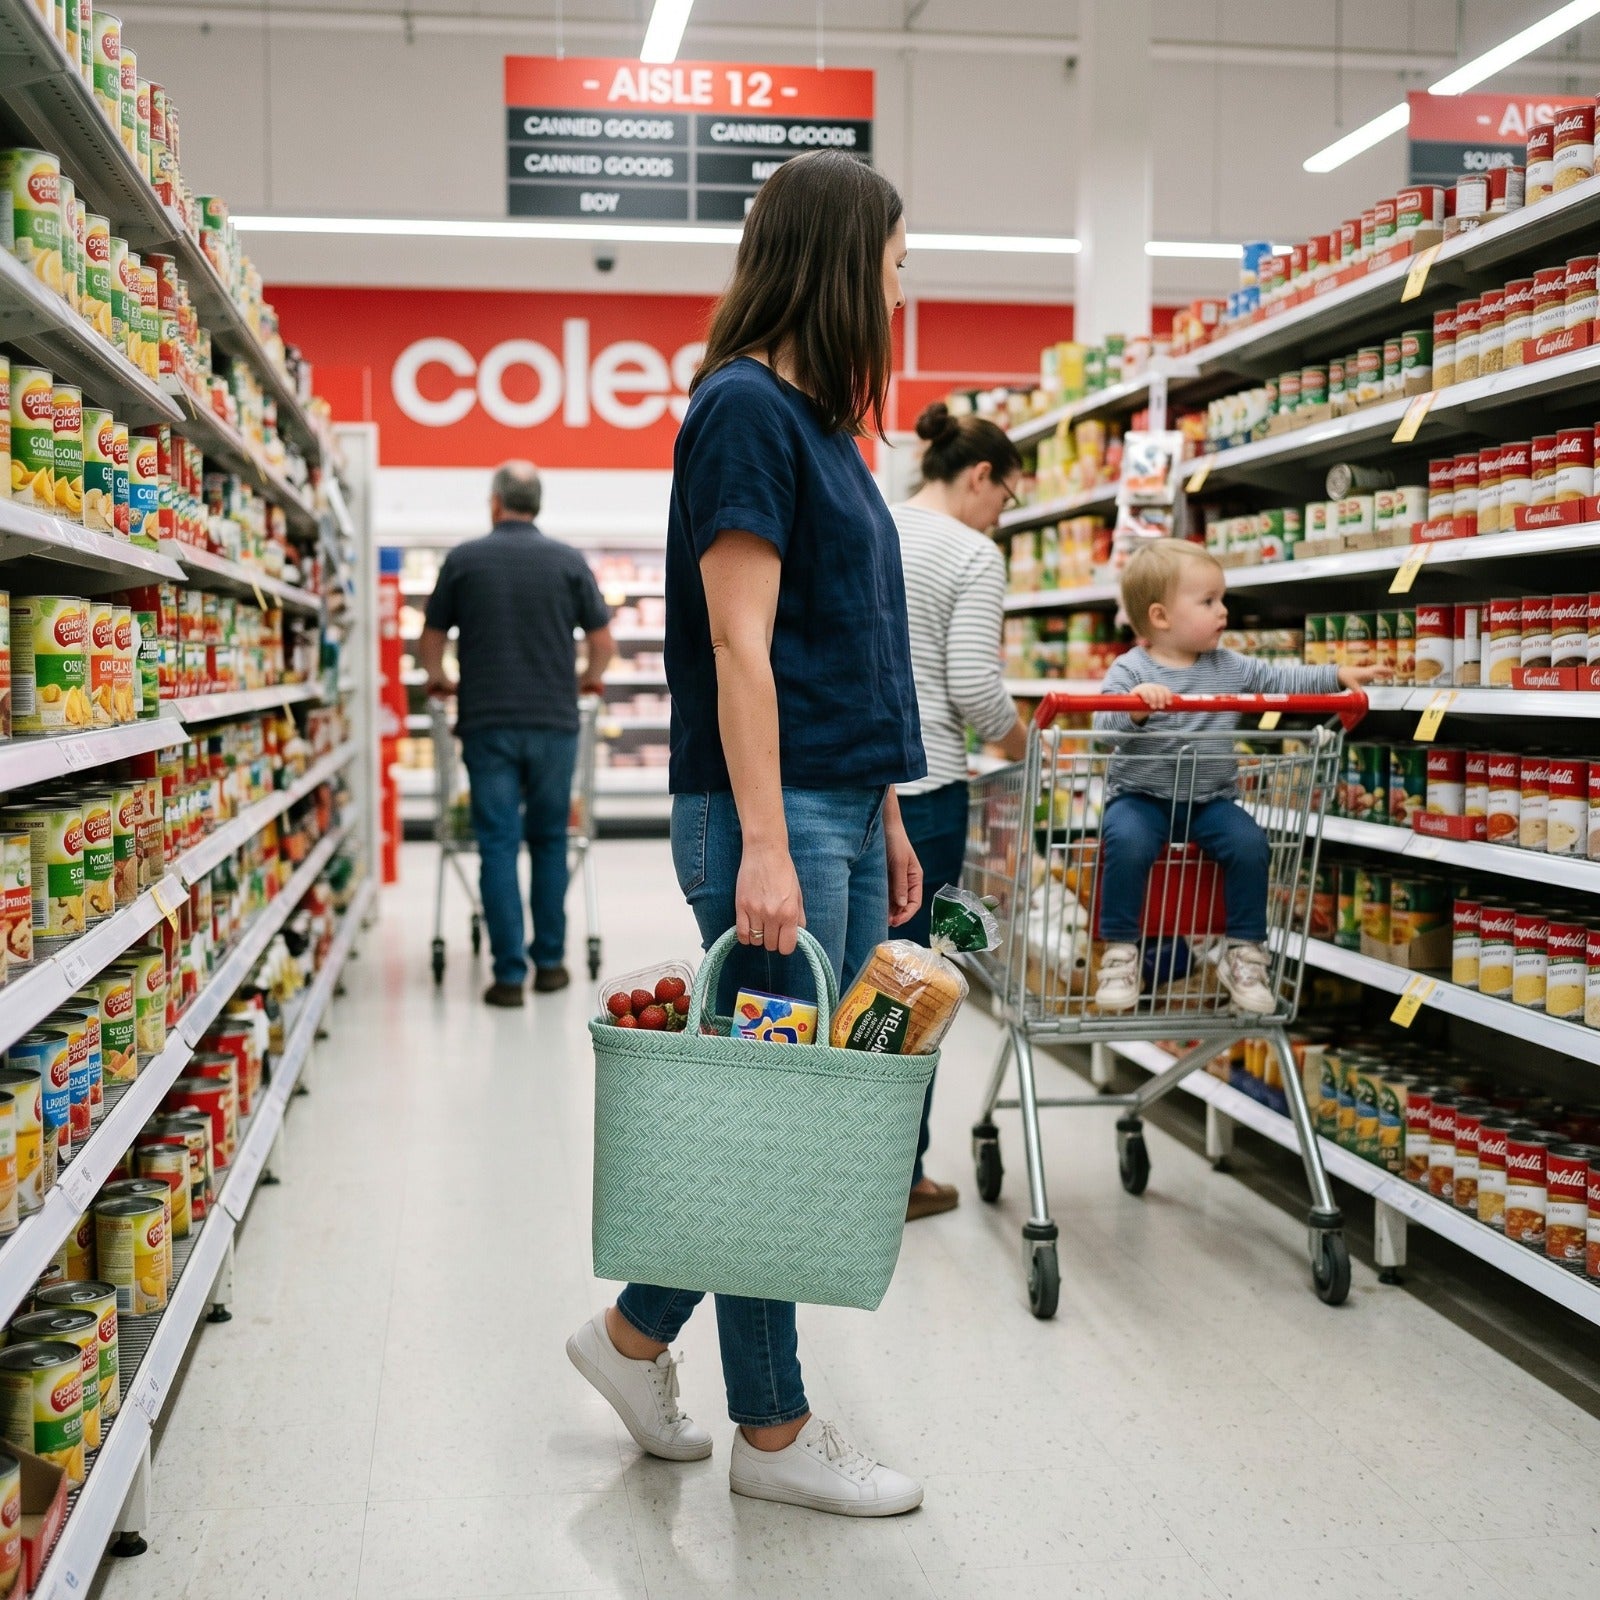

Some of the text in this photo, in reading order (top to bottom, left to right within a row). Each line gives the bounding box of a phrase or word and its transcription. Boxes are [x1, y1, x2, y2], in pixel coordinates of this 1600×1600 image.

[607, 67, 713, 105] AISLE
[725, 71, 773, 107] 12
[524, 116, 674, 139] CANNED GOODS
[711, 122, 856, 145] CANNED GOODS
[524, 153, 674, 177] CANNED GOODS
